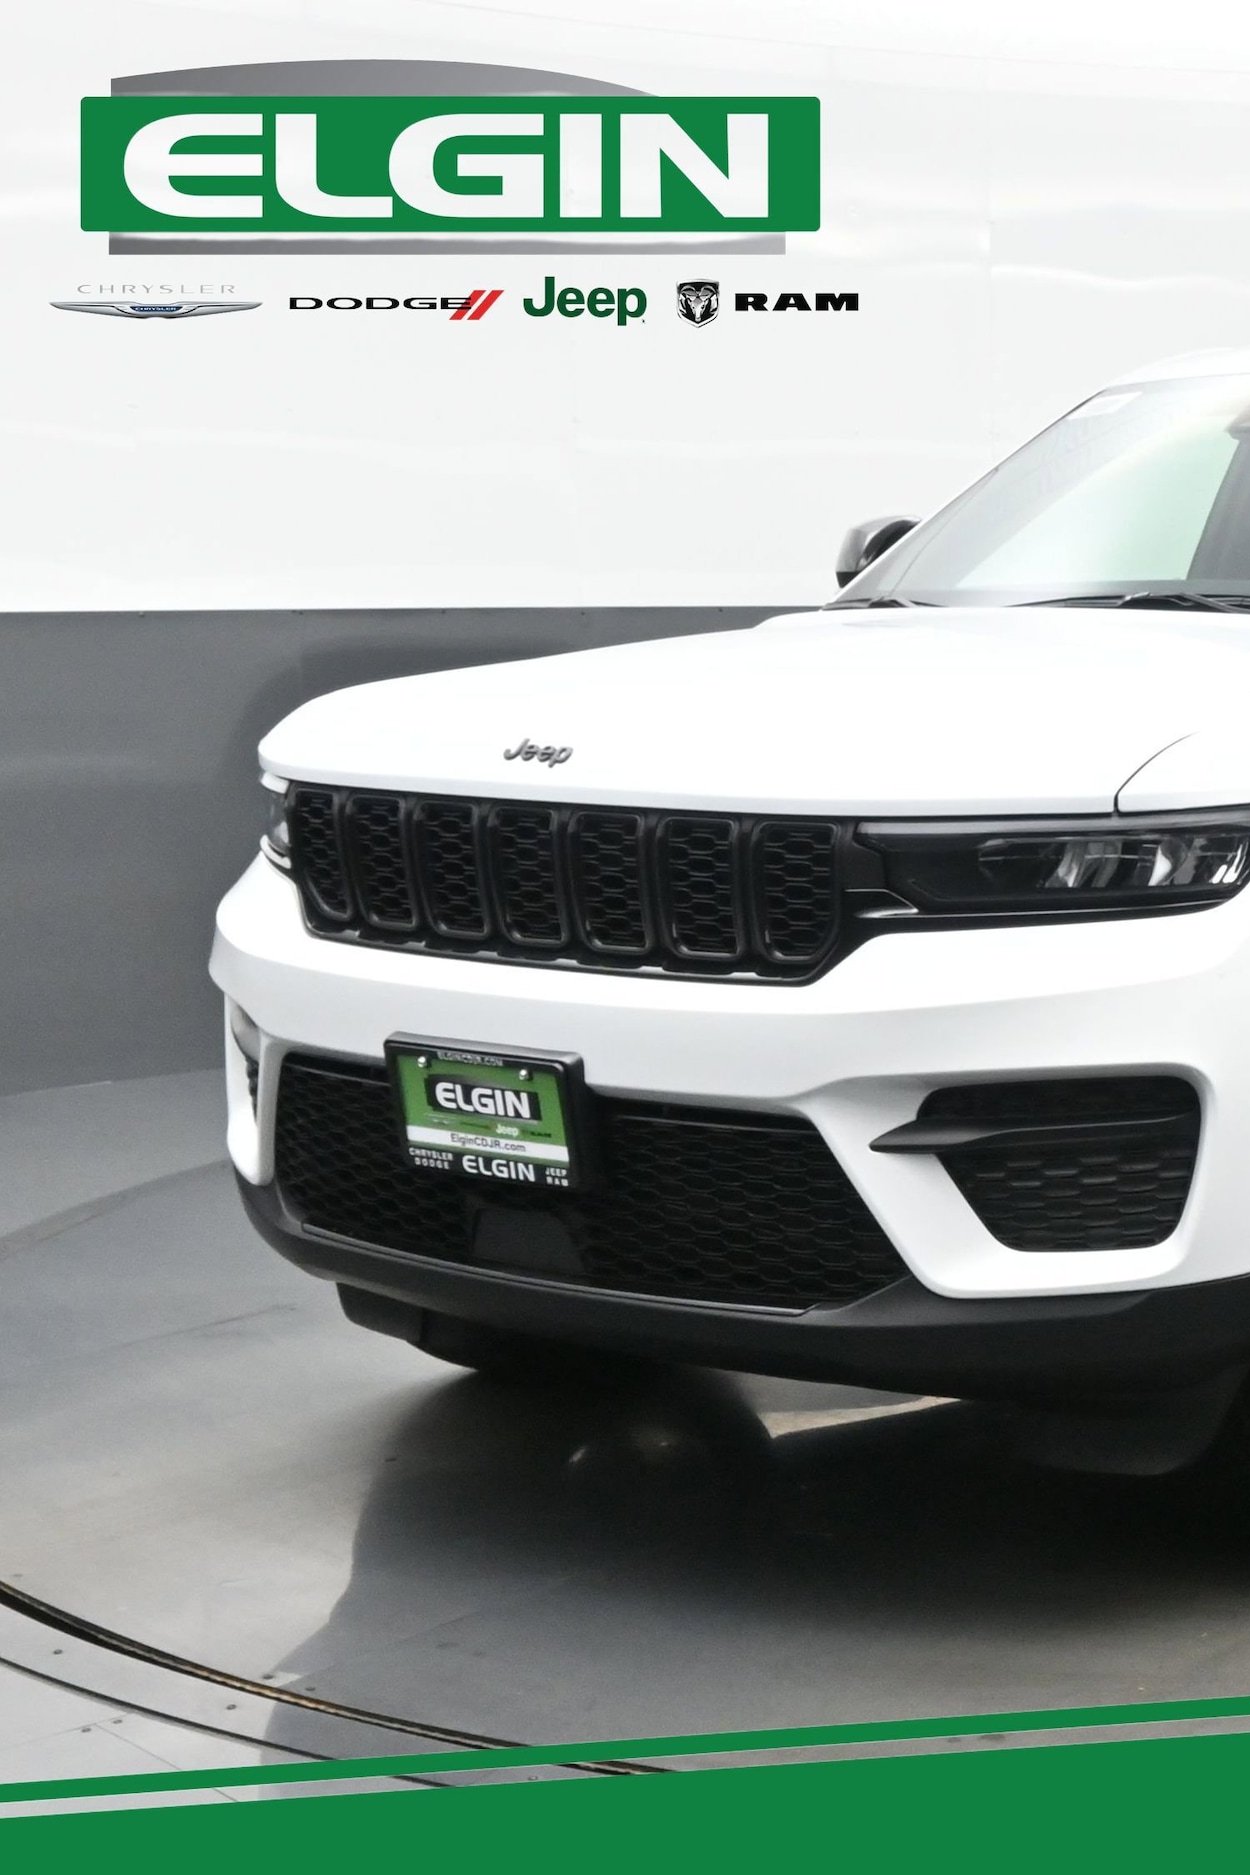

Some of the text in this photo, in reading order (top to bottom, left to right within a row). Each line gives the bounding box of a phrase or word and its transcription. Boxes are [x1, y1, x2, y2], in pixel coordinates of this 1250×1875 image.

[503, 738, 573, 768] Jeep
[435, 1081, 531, 1119] ELGIN
[496, 1124, 520, 1138] Jeep
[450, 1133, 526, 1153] ElginCDJR.com
[409, 1147, 453, 1161] CHRYSLER
[415, 1158, 449, 1170] DODGE
[462, 1155, 536, 1182] ELGIN
[545, 1167, 567, 1176] JEEP
[546, 1176, 569, 1187] RAM
